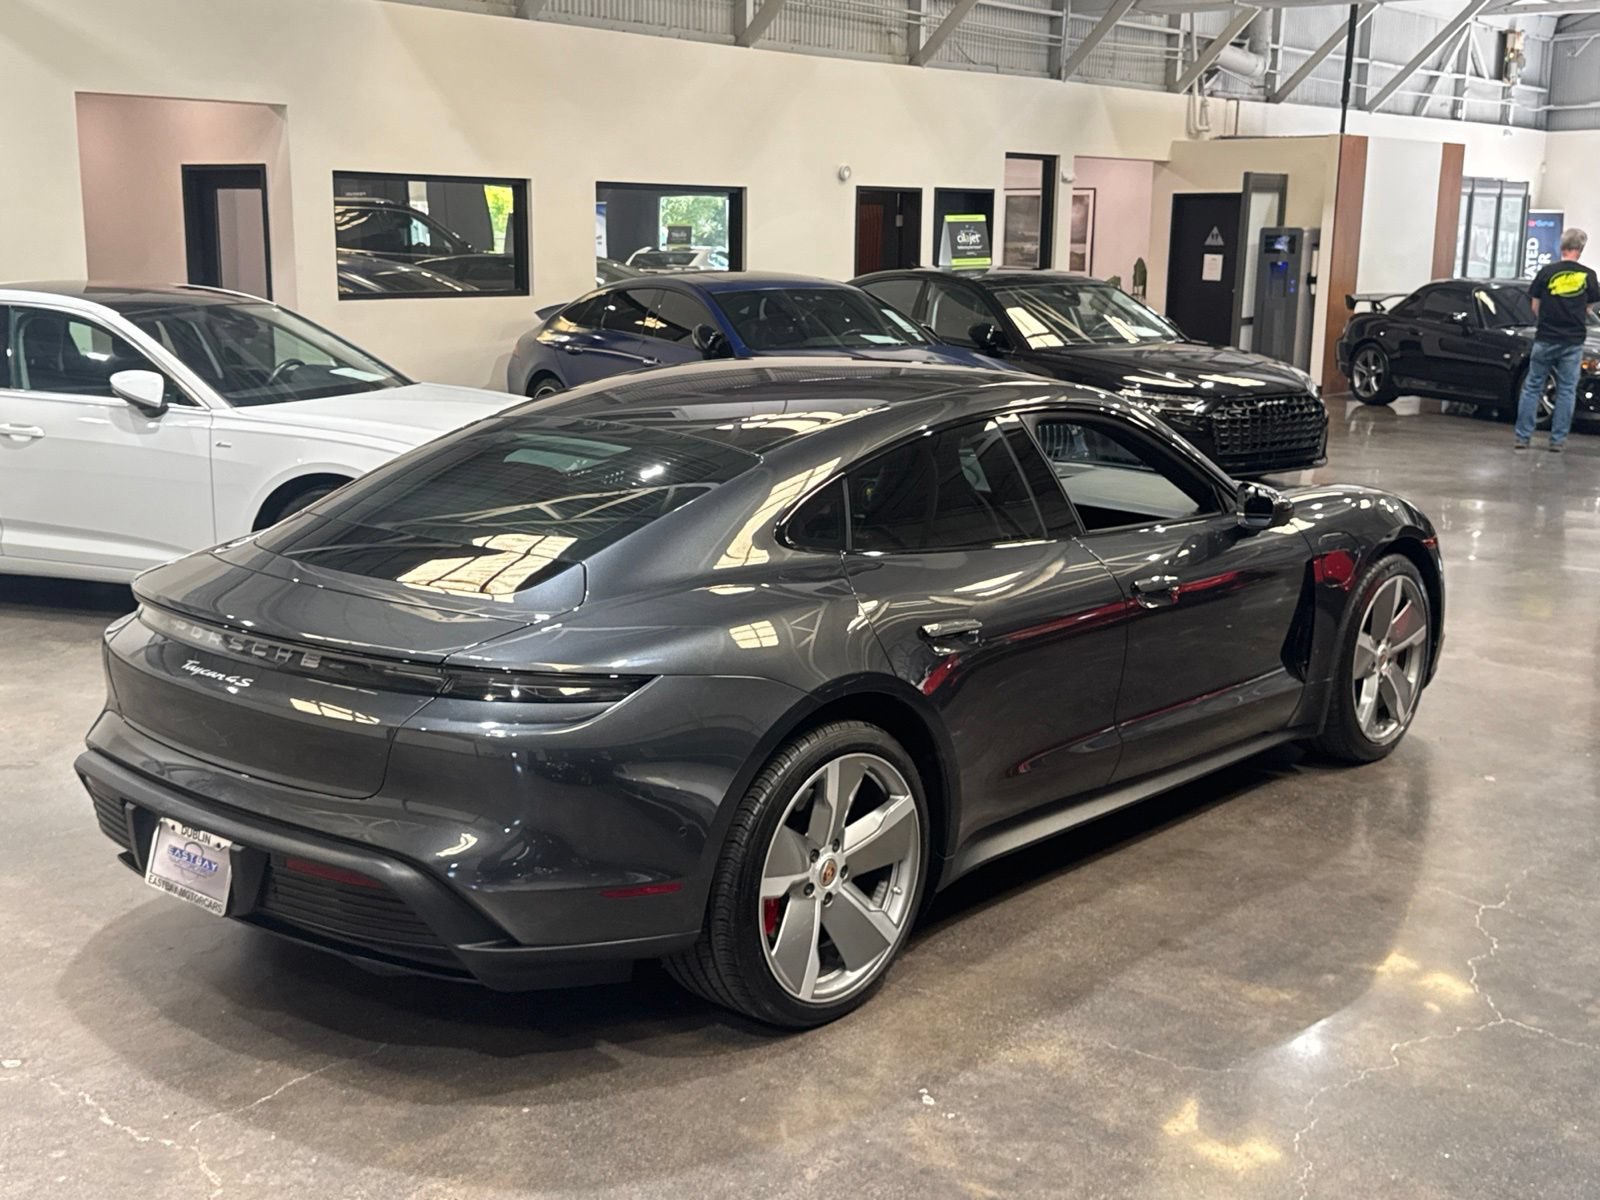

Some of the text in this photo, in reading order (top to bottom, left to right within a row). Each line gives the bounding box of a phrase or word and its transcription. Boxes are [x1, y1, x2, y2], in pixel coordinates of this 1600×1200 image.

[174, 620, 322, 668] PORSCHE
[181, 659, 254, 688] Taycan 4S
[181, 826, 211, 844] DUBLIN
[179, 885, 223, 914] MOTORCARS
